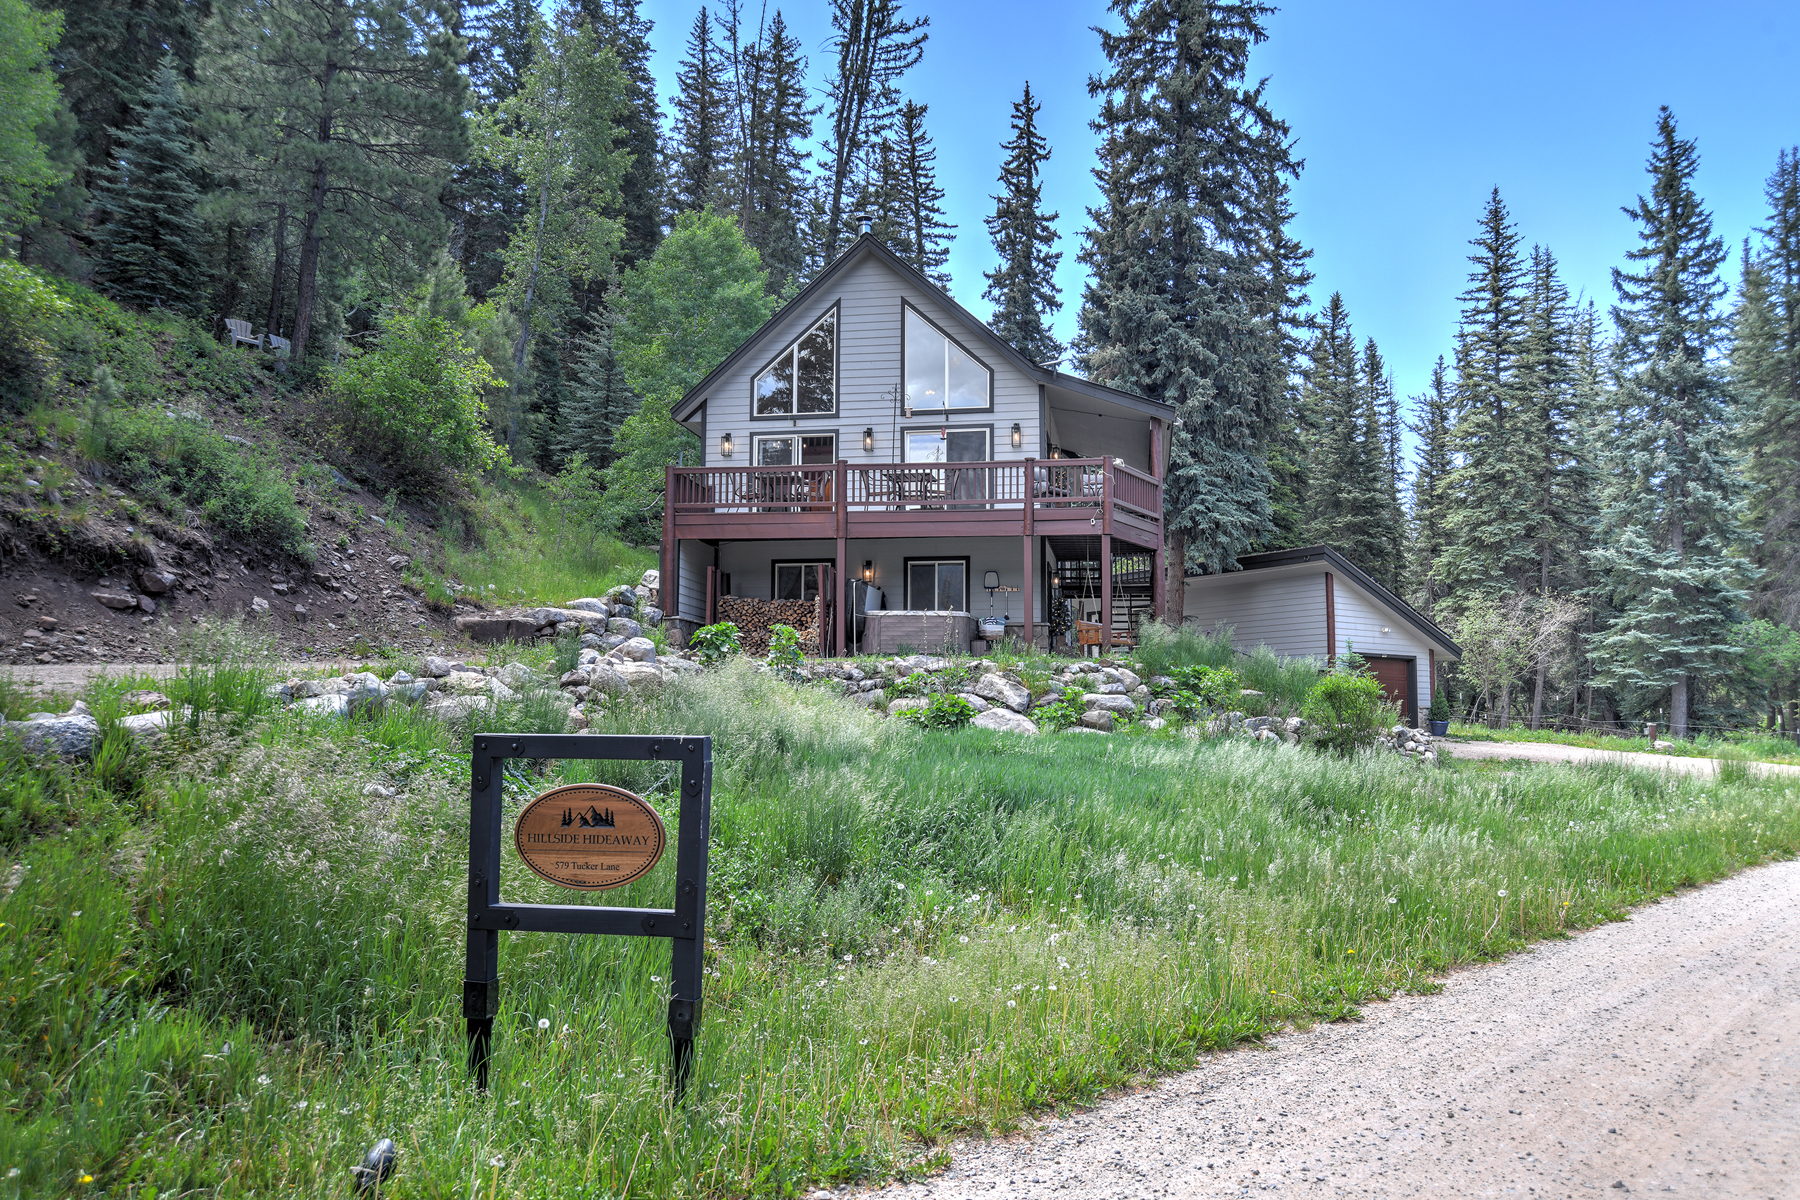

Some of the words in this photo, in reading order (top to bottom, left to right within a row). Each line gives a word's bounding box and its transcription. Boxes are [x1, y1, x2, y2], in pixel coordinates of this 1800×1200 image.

[527, 833, 580, 845] HILLSIDE
[582, 834, 650, 846] HIDEAWAY
[555, 861, 570, 870] 579
[571, 861, 599, 871] Tucker
[600, 862, 620, 871] Lane
